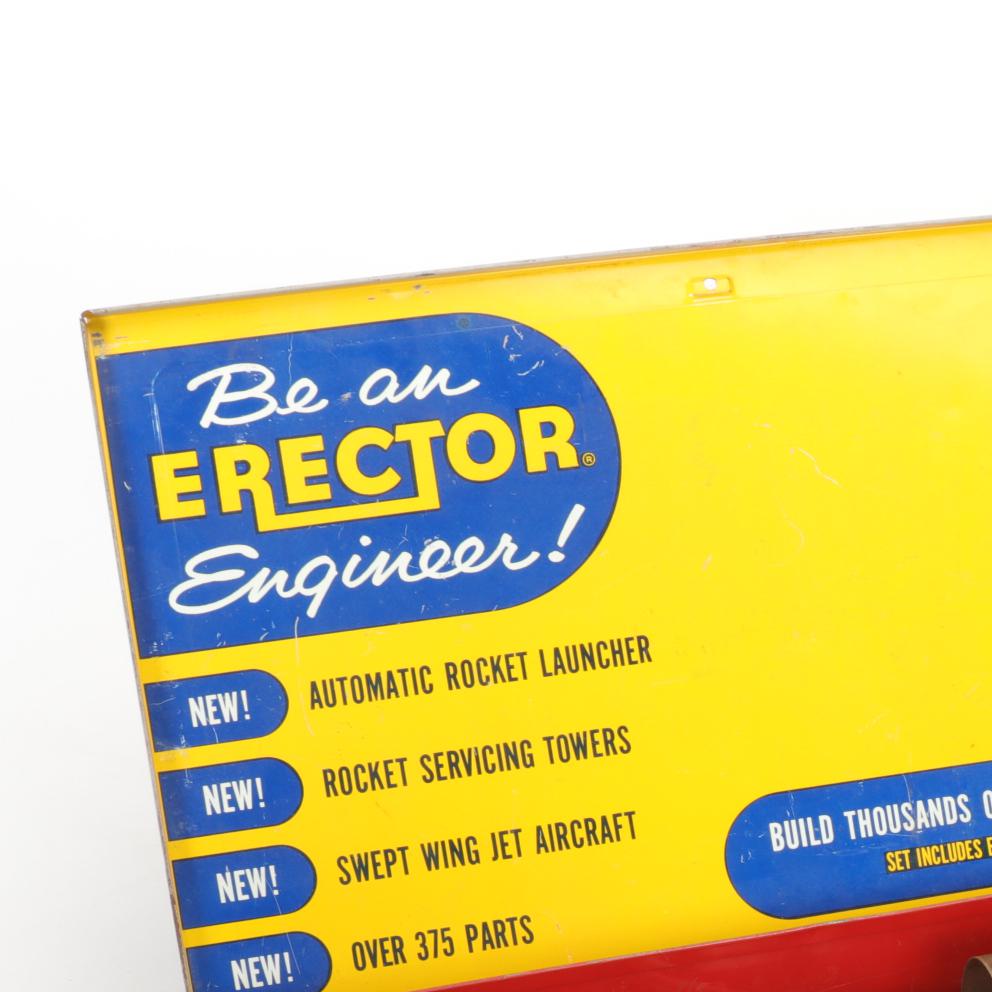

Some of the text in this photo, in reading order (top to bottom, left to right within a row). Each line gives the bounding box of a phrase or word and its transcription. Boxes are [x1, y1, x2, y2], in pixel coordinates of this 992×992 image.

[187, 362, 480, 428] Be an
[168, 503, 586, 618] Engineer!
[309, 635, 653, 711] AUTOMATIC ROCKET LAUNCHER
[188, 690, 251, 728] NEW!
[323, 725, 632, 798] ROCKET SERVICING TOWERS
[202, 777, 266, 816] NEW!
[769, 814, 835, 852] BUILD
[843, 793, 972, 840] THOUSANDS
[336, 811, 638, 885] SWEPT WING JET AIRCRAFT
[886, 849, 911, 873] SET
[917, 839, 984, 868] INCLUDES
[216, 865, 279, 904] NEW!
[231, 951, 293, 991] NEW!
[351, 915, 535, 973] OVER 375 PARTS
